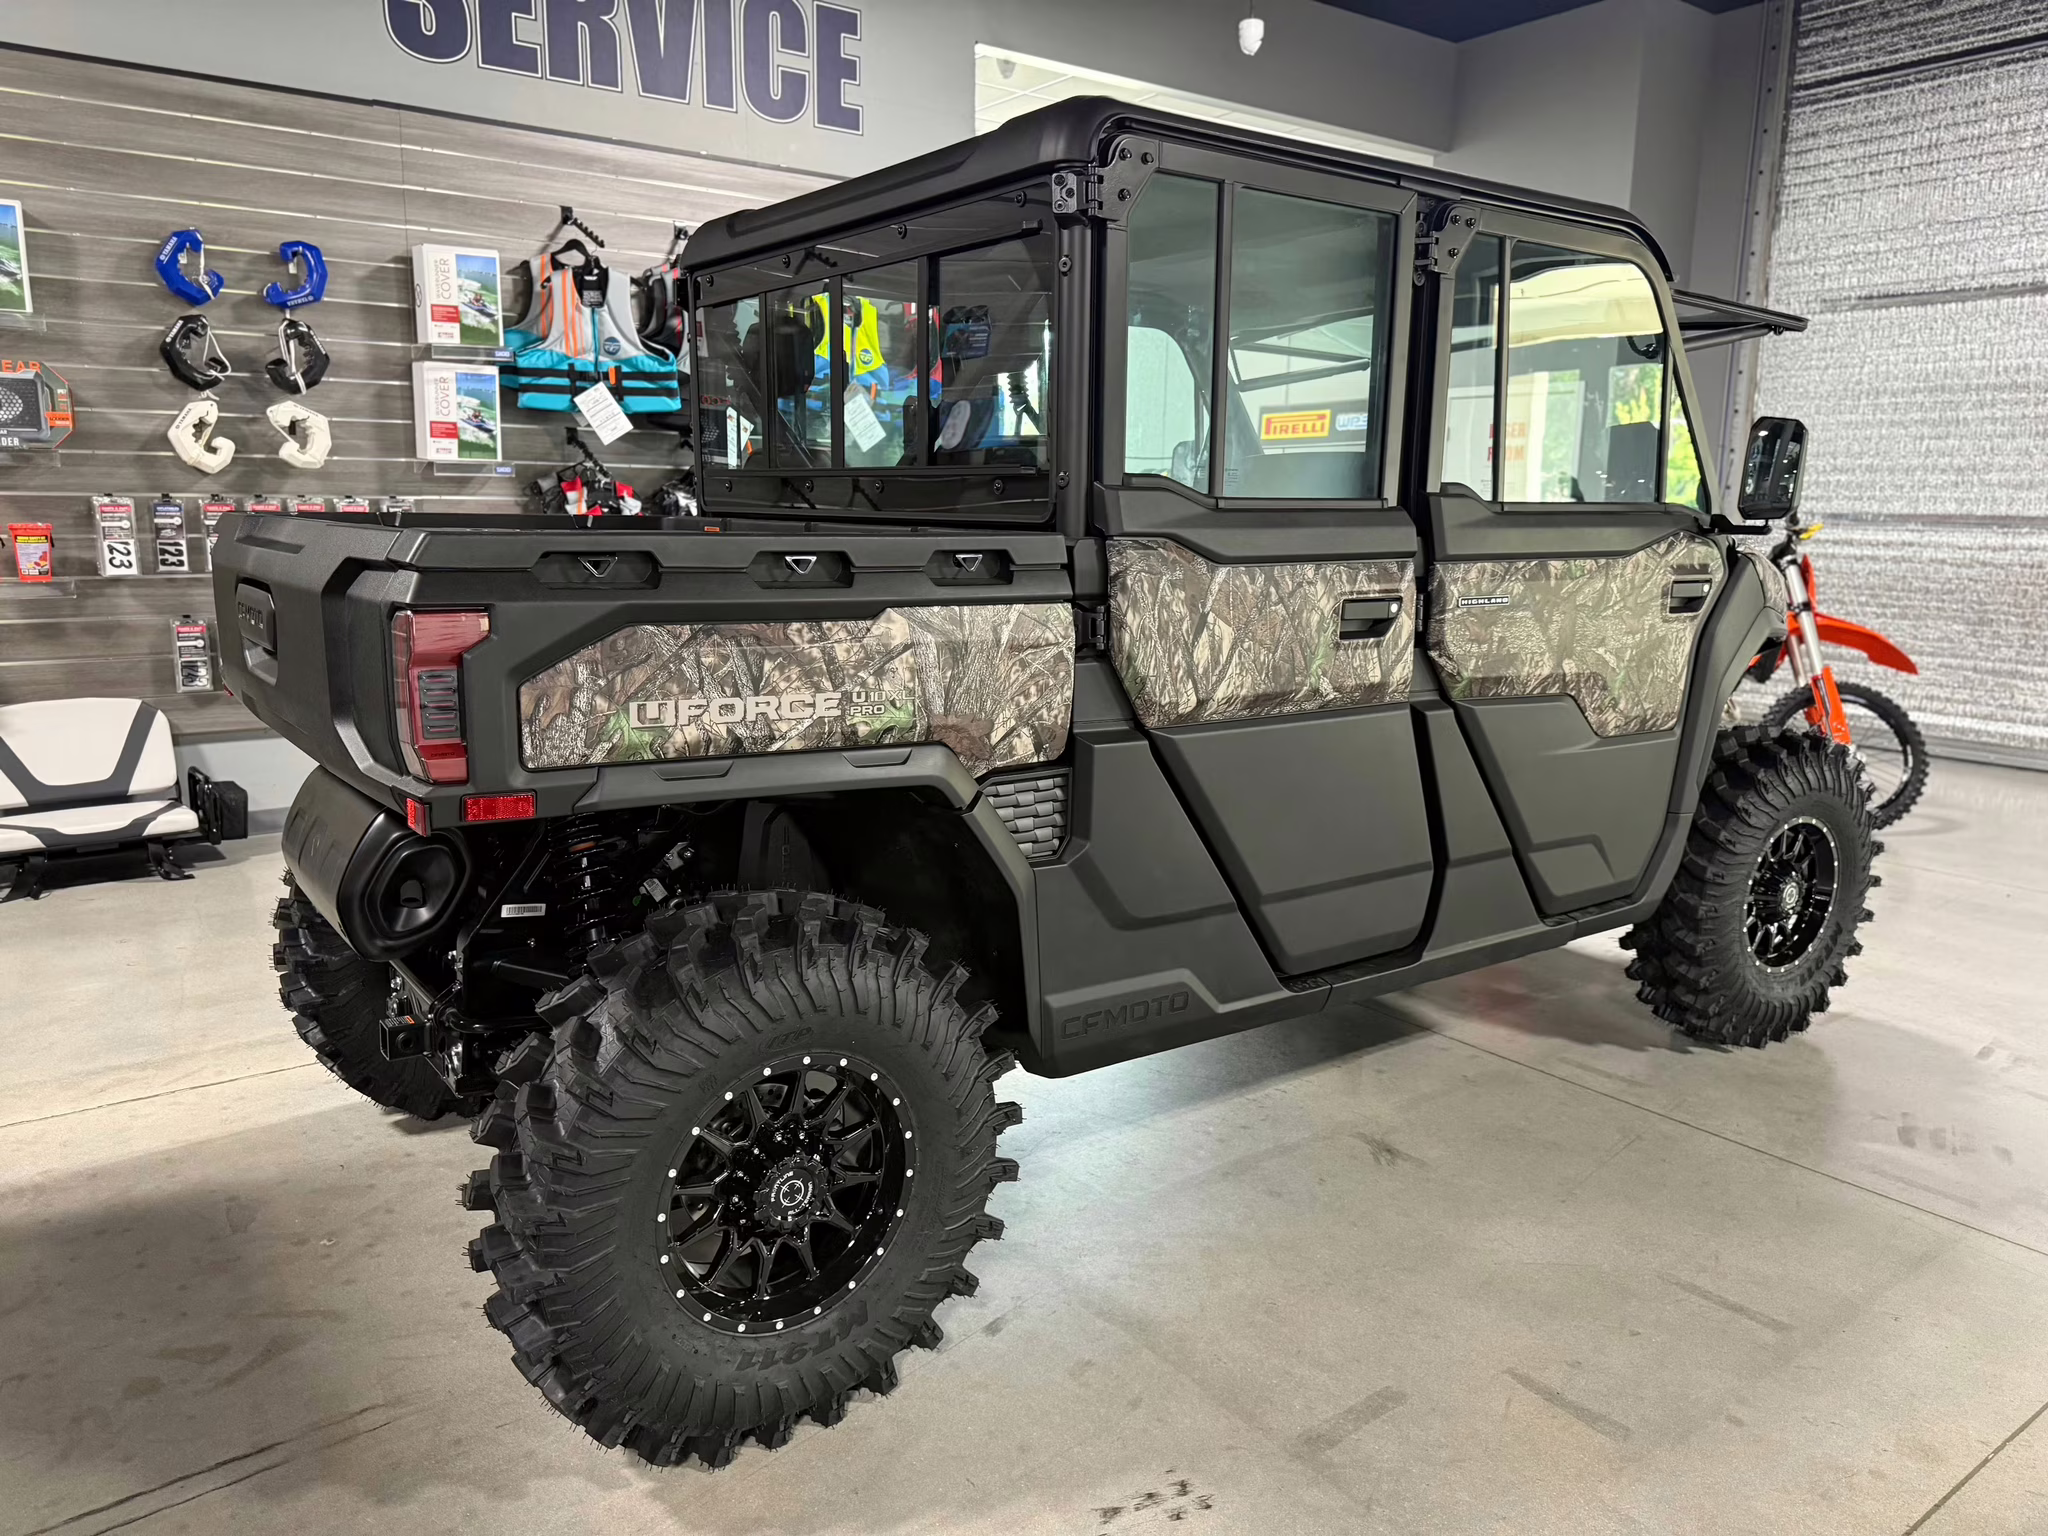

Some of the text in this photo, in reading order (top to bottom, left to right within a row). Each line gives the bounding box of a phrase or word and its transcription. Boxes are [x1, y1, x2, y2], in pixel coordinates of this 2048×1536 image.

[439, 258, 452, 300] COVER
[169, 320, 184, 338] YAMAHA
[439, 376, 451, 417] COVER
[1264, 414, 1328, 436] PIRELLI
[107, 540, 134, 570] 123
[158, 540, 186, 568] 123
[1461, 597, 1509, 605] HIGHLAND
[850, 704, 886, 717] PRO
[1060, 990, 1190, 1040] CFMOTO
[770, 1170, 795, 1203] FRONTLINE
